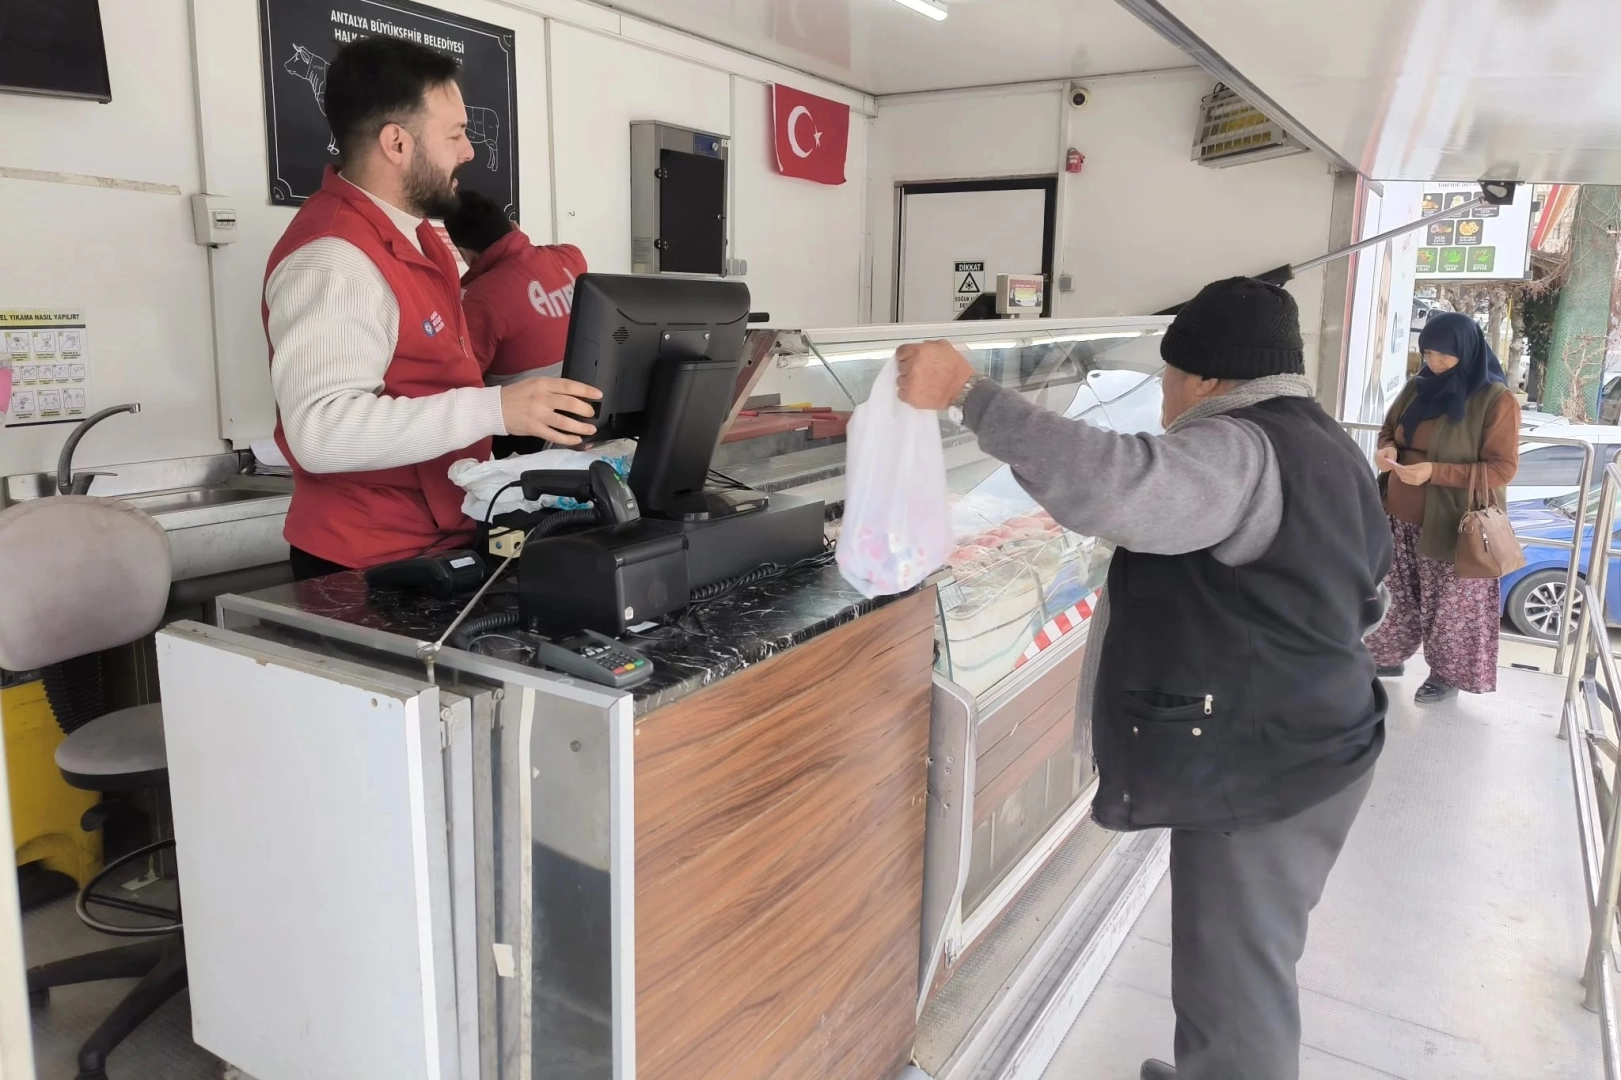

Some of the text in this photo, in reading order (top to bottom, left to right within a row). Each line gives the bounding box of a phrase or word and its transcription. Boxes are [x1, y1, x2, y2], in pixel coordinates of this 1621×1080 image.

[331, 10, 368, 30] ANTALYA
[424, 34, 465, 54] BELEDİYESİ
[959, 263, 981, 271] DİKKAT
